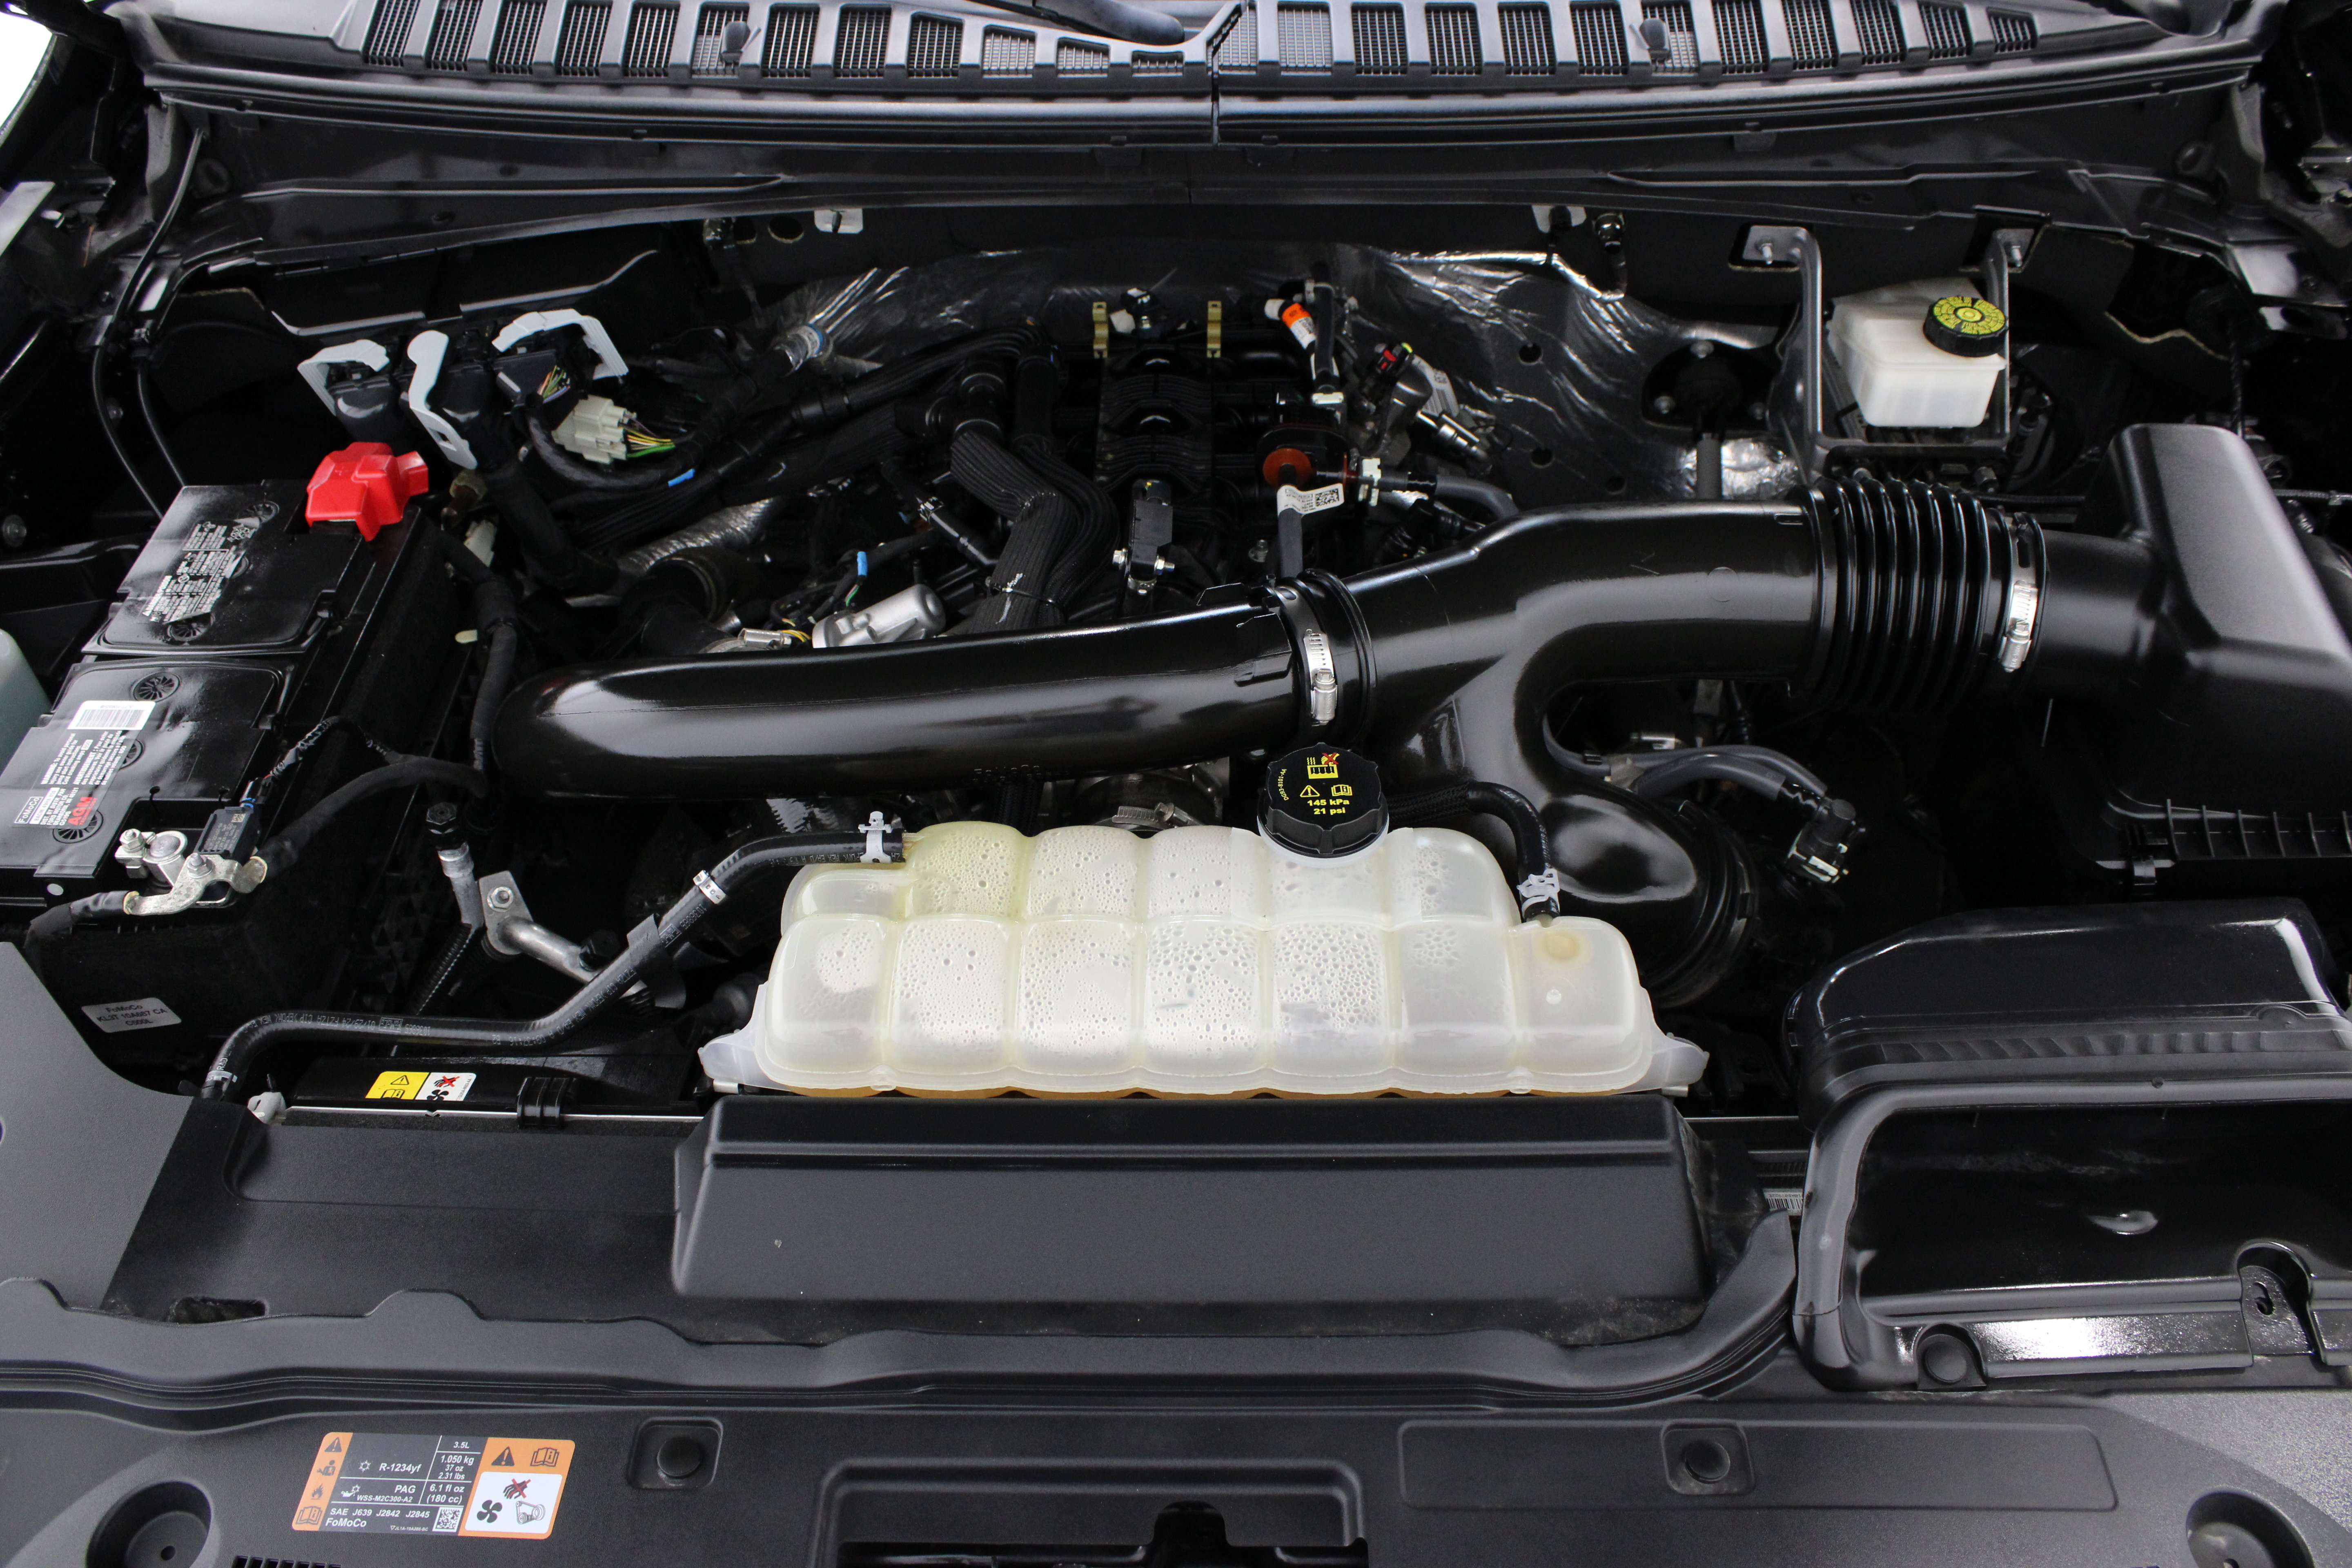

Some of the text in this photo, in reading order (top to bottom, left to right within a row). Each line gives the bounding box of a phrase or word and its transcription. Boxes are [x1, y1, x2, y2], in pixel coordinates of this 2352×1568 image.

[65, 745, 76, 754] guide
[40, 762, 58, 784] WARNING:
[57, 748, 67, 757] avoid
[64, 733, 76, 747] personal
[61, 766, 69, 774] start
[62, 776, 71, 784] Cold
[67, 760, 81, 775] cranking
[76, 750, 87, 760] amps
[72, 751, 96, 784] AVERTISSEMENT
[1278, 768, 1289, 801] DG93-8101-AA
[18, 797, 40, 822] FoMoCo
[39, 815, 51, 824] DIST.
[49, 796, 62, 808] DISTR.
[45, 815, 57, 825] FORD
[52, 800, 65, 814] MOTOR
[51, 804, 70, 825] DEARBORN,
[68, 787, 79, 797] 48121
[65, 796, 93, 825] AGM
[105, 1004, 143, 1013] FoMoCo
[216, 1058, 228, 1071] RAD
[441, 1455, 474, 1466] 1.050 kg
[379, 1463, 422, 1474] R-1234yf
[394, 1485, 416, 1493] PAG
[357, 1494, 413, 1503] WSS-M2C300-A2
[427, 1494, 462, 1505] (180 cc)
[325, 1518, 367, 1527] FoMoCo
